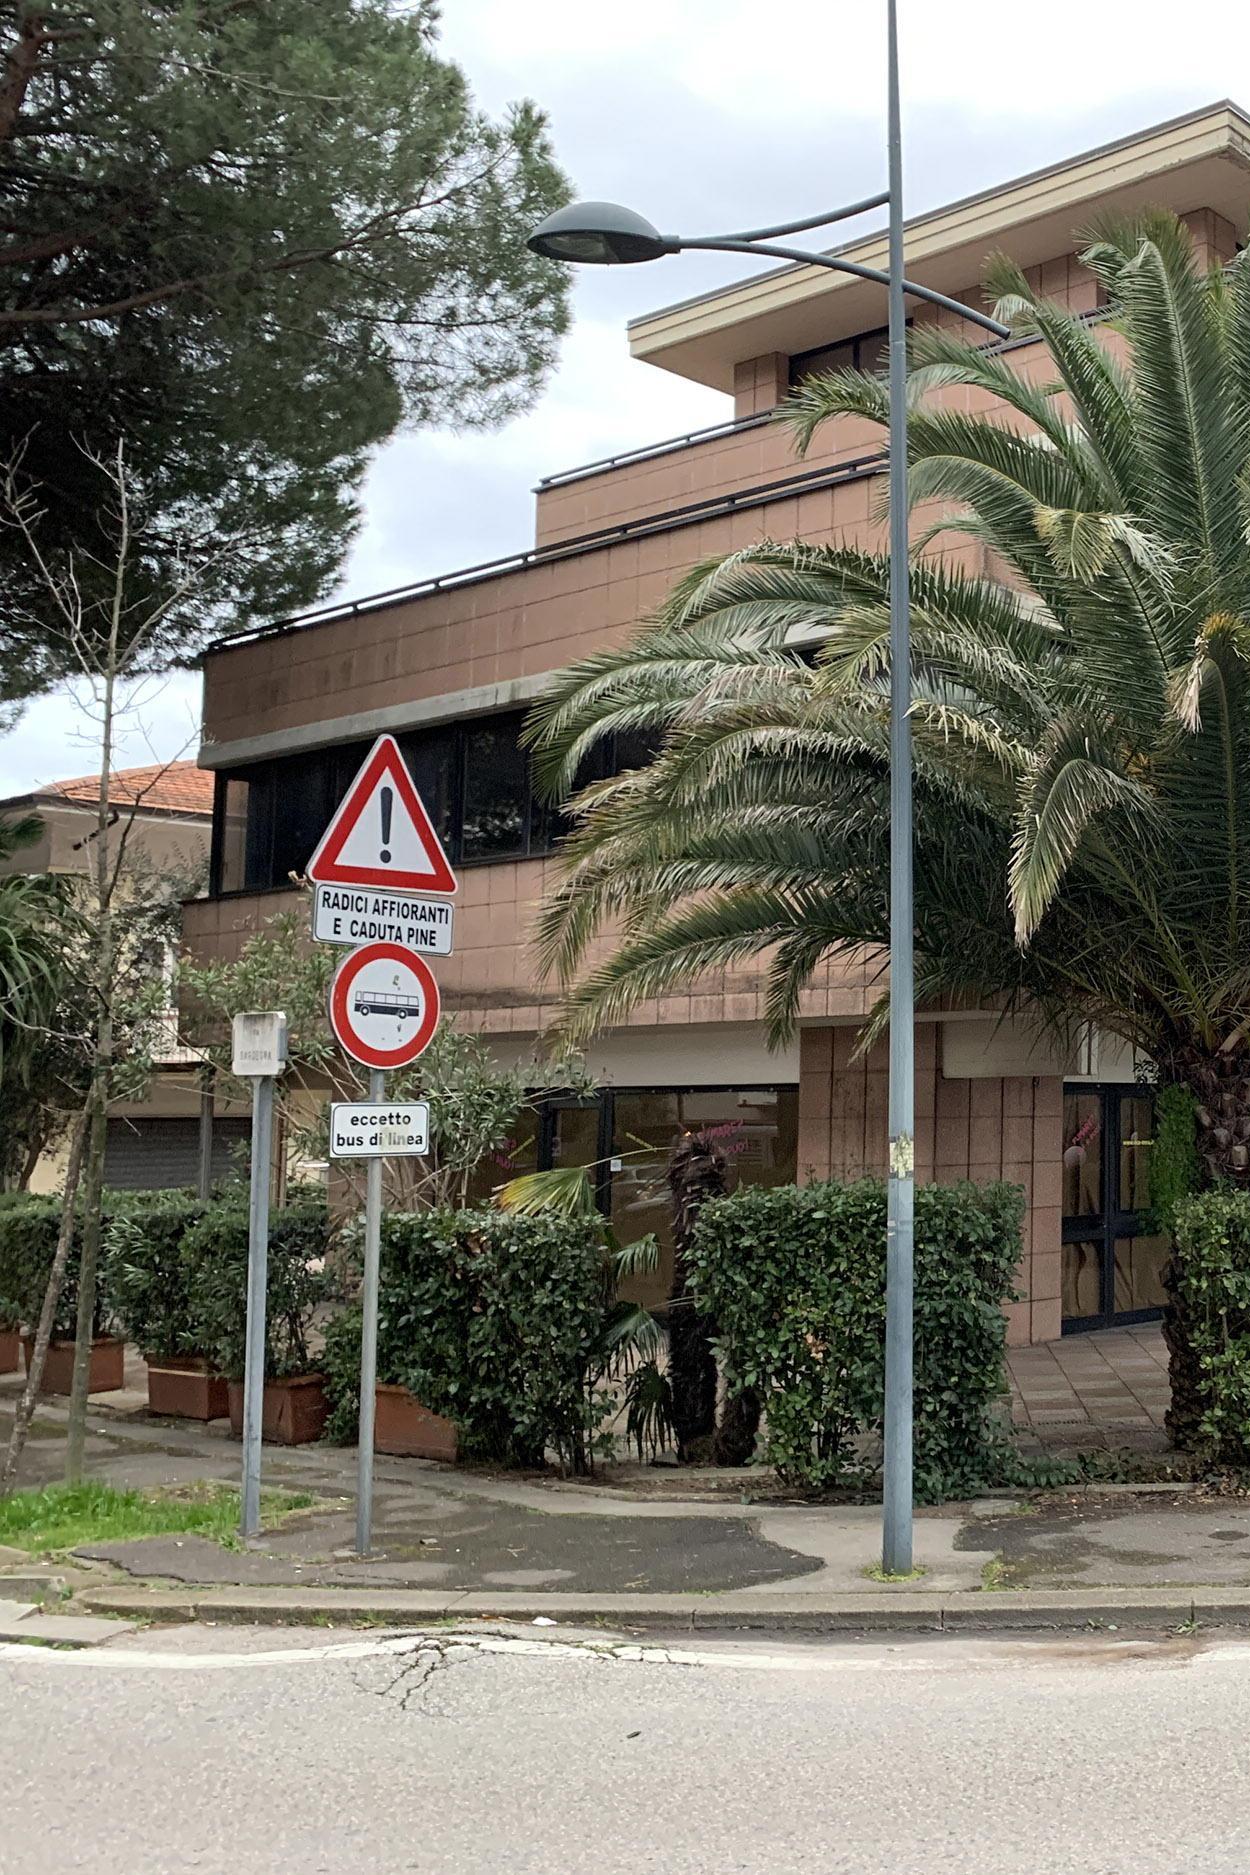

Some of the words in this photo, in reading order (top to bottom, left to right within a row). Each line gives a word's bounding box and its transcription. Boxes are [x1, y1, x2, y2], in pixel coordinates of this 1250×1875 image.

[322, 891, 368, 914] RADICI
[372, 899, 449, 925] AFFIORANTI
[333, 917, 341, 935] E
[350, 920, 403, 943] CADUTA
[407, 927, 437, 946] PINE
[350, 1112, 411, 1126] eccetto
[337, 1133, 364, 1147] bus
[369, 1133, 382, 1146] di
[388, 1132, 423, 1146] linea
